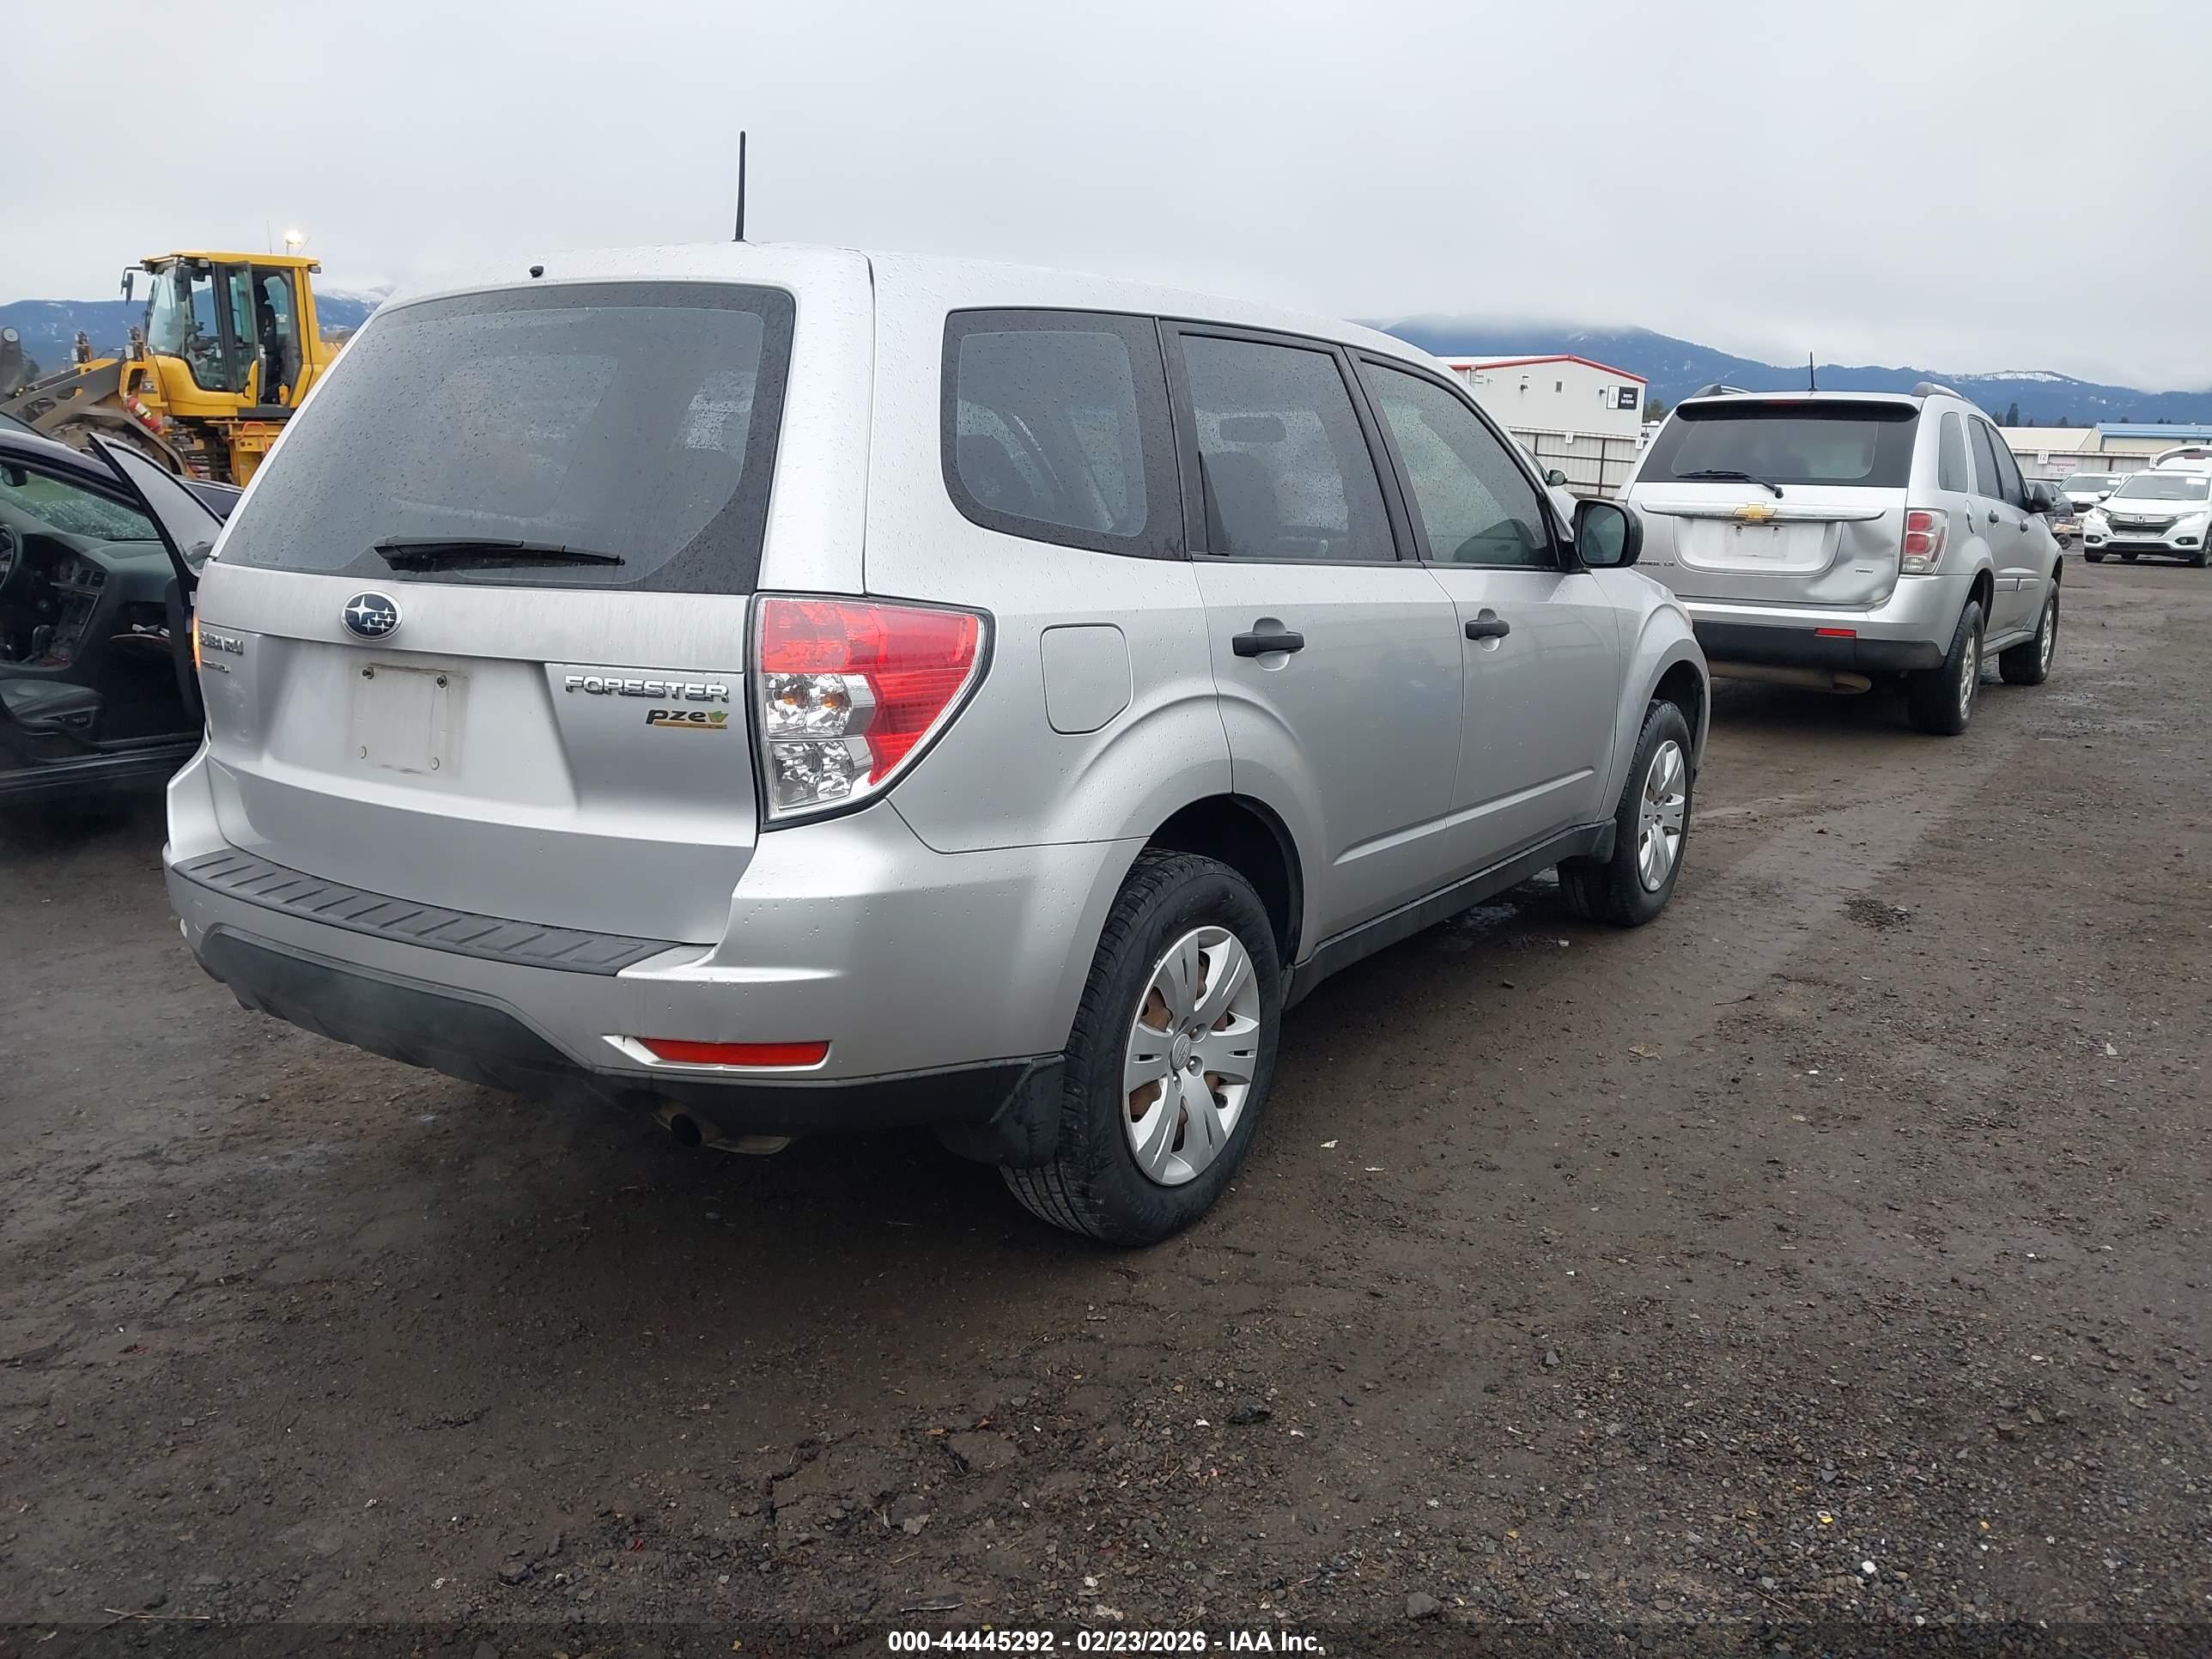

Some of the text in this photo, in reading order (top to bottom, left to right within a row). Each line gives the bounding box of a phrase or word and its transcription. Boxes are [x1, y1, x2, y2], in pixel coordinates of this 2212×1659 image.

[198, 630, 244, 656] SUBARU
[565, 675, 729, 703] FORESTER
[646, 708, 729, 726] pzev
